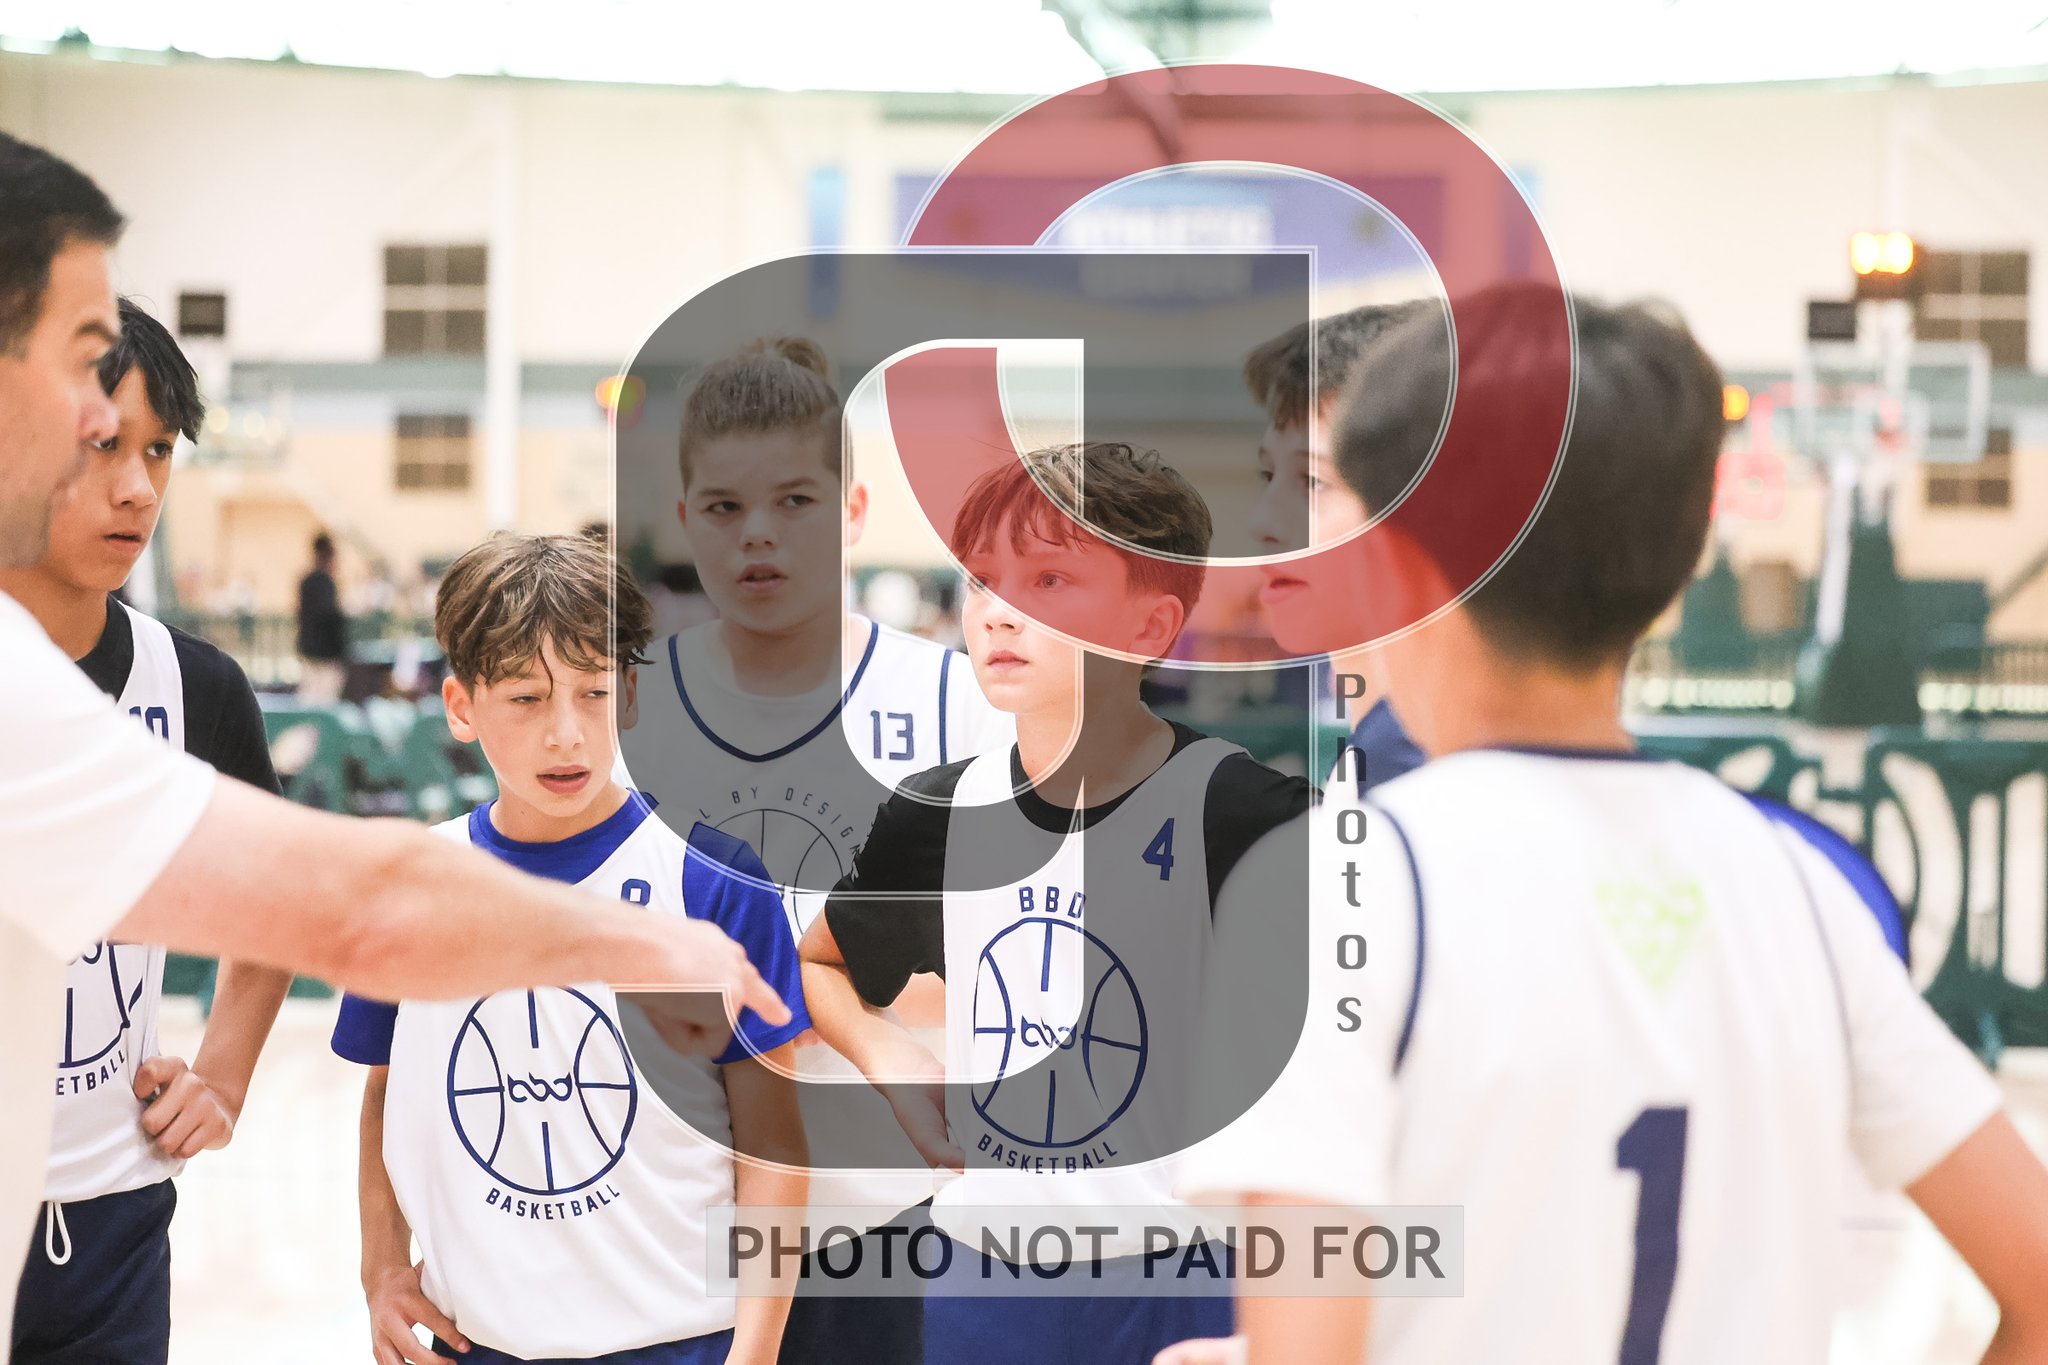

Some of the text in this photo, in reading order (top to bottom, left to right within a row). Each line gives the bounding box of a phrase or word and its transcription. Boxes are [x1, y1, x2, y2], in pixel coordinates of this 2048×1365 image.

[129, 705, 170, 741] 0
[870, 709, 914, 761] 13
[731, 786, 758, 804] BY
[1141, 817, 1175, 881] 4
[55, 1049, 127, 1096] ETBALL
[977, 1133, 1118, 1174] BASKETBALL
[485, 1184, 620, 1220] BASKETBALL
[1615, 1106, 1689, 1365] 1
